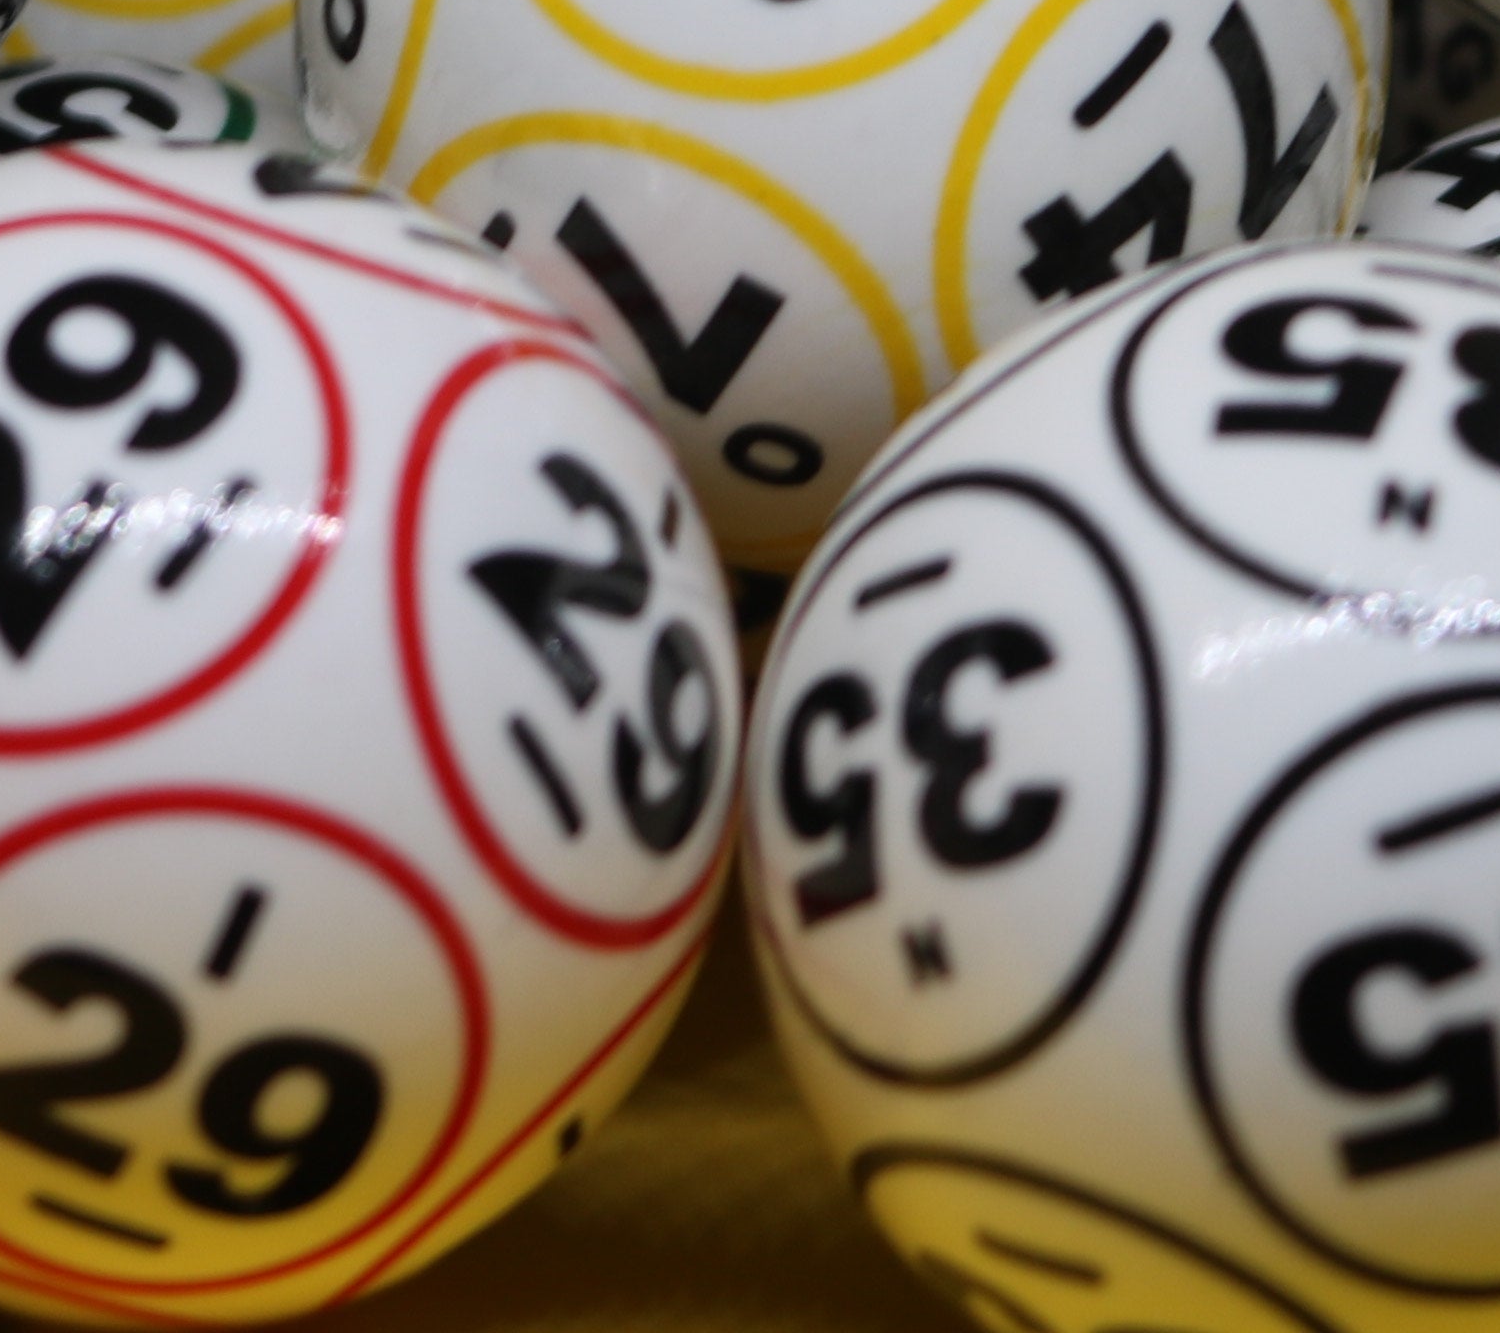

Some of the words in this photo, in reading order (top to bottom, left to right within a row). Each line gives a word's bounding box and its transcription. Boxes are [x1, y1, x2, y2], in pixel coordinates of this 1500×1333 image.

[720, 422, 825, 489] O
[1376, 477, 1439, 532] N
[466, 450, 721, 858] 29
[777, 619, 1065, 928] 35
[898, 917, 953, 987] N
